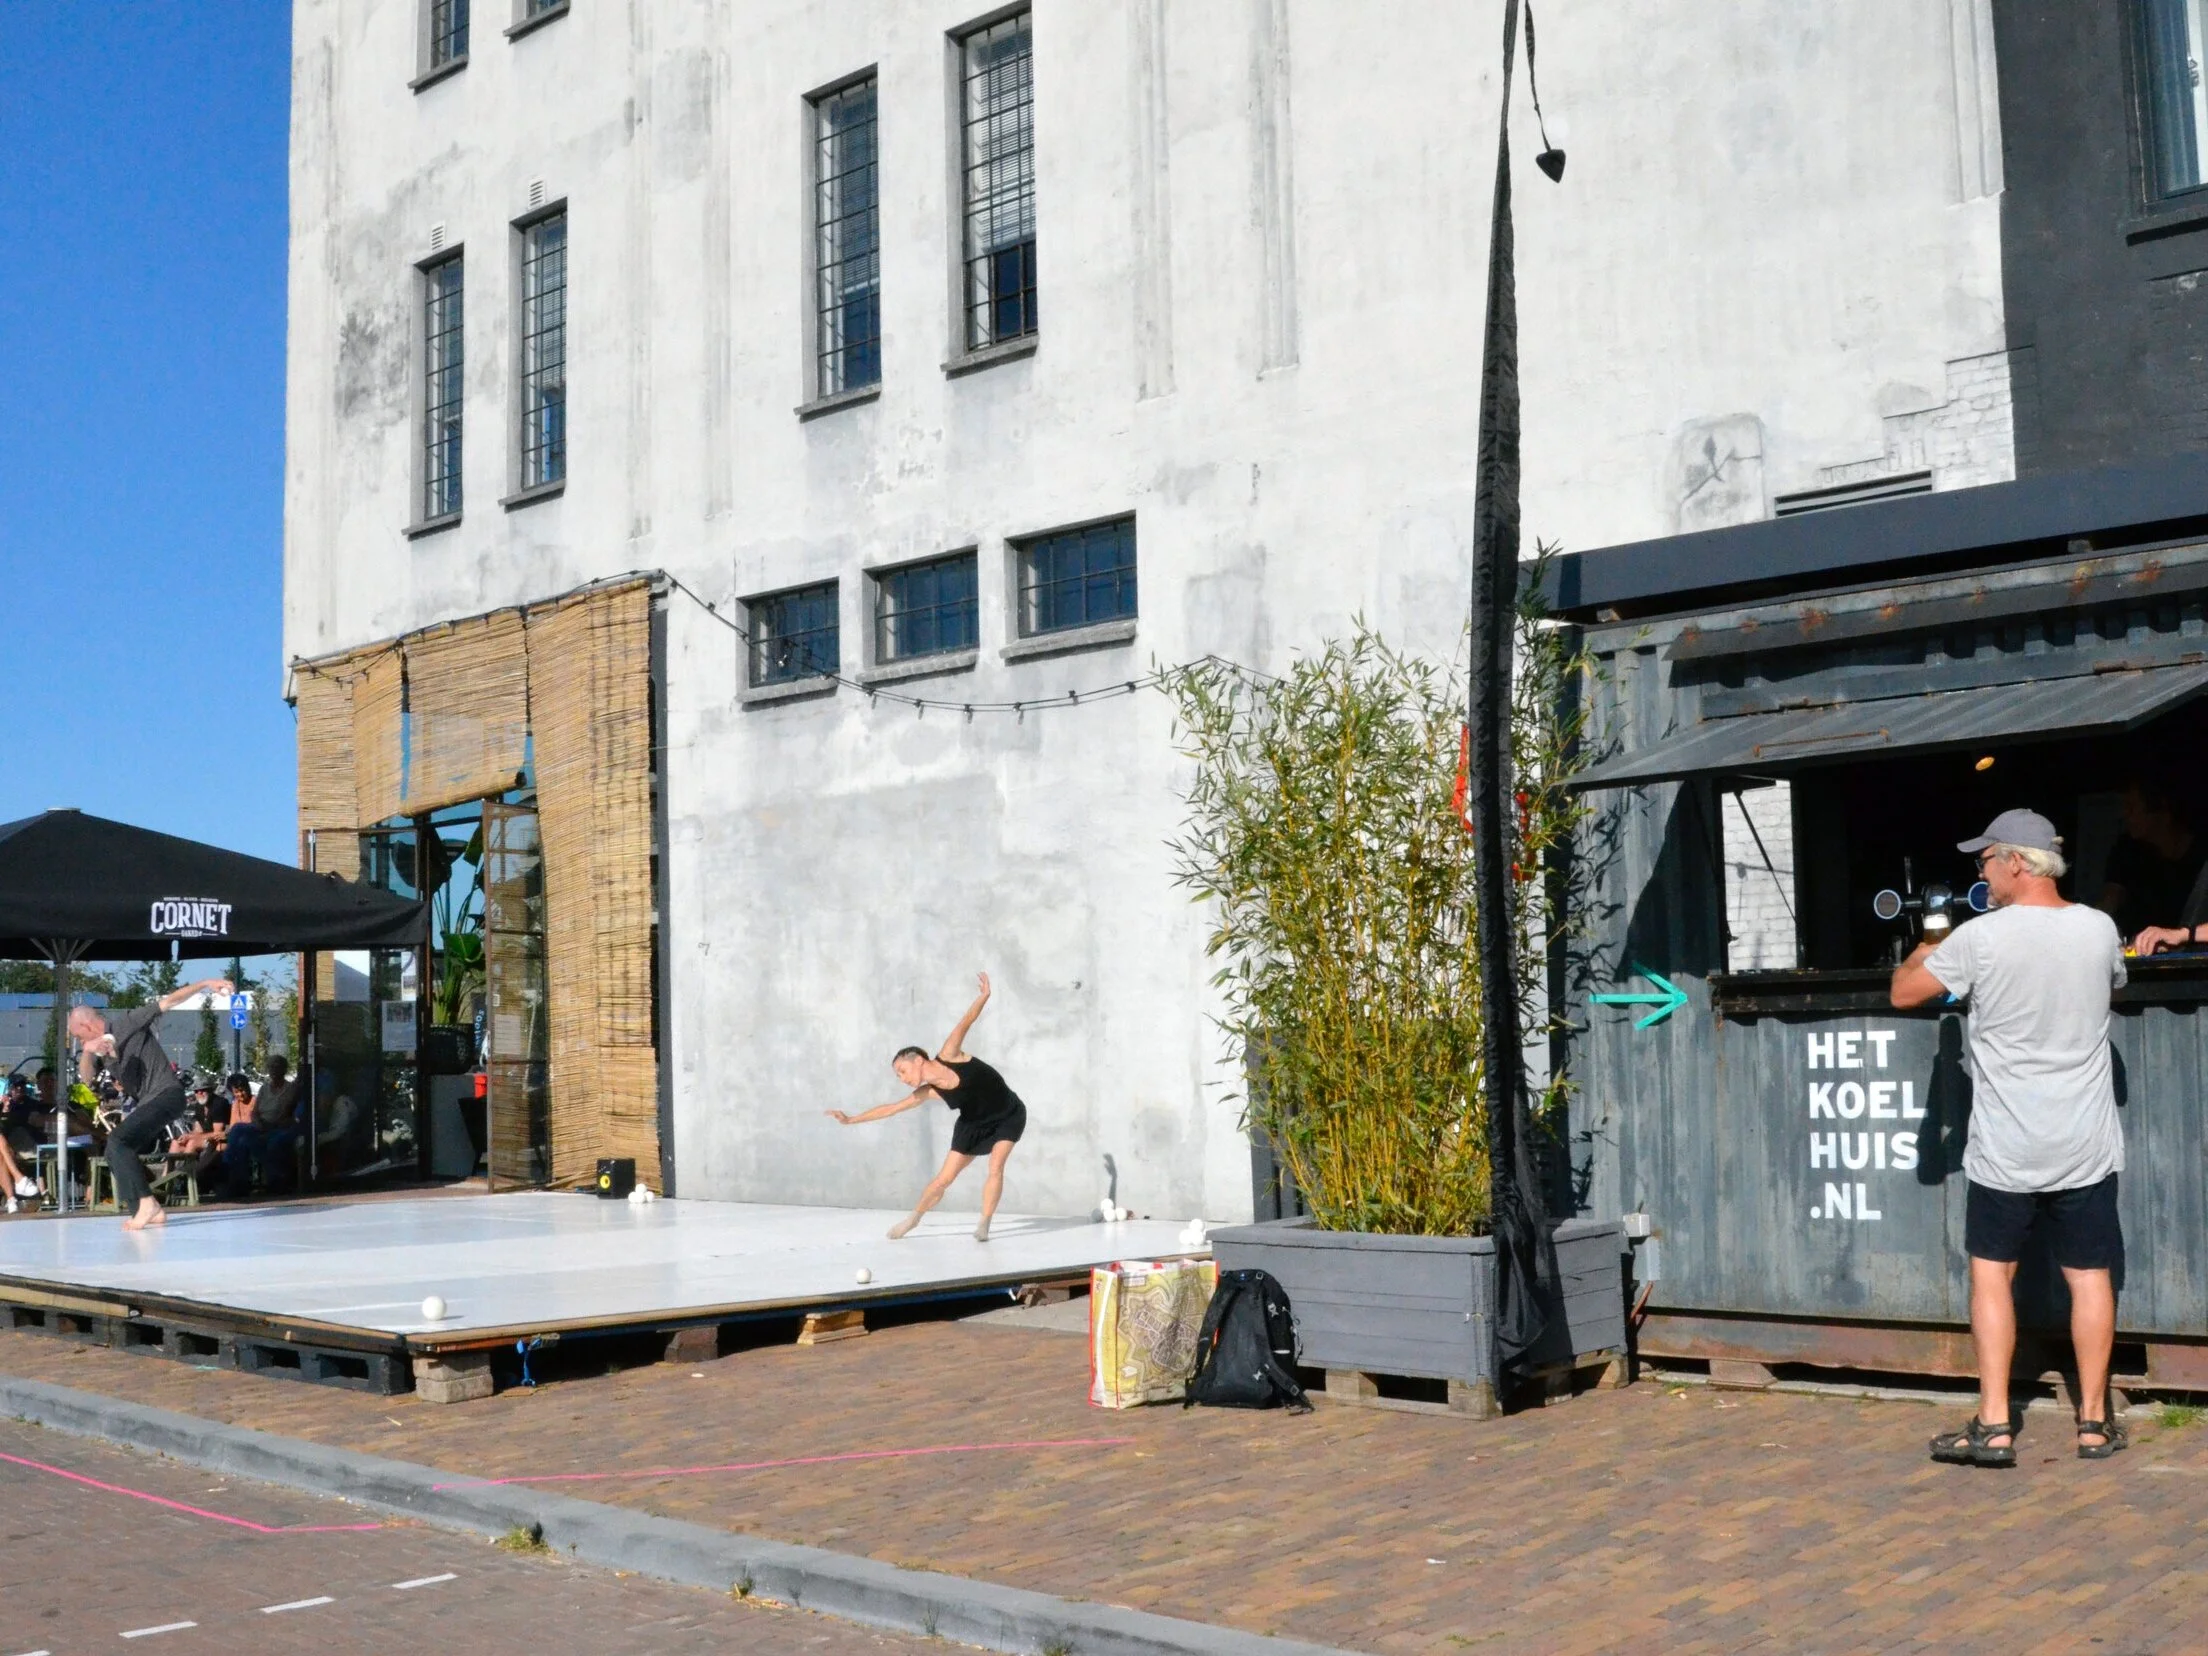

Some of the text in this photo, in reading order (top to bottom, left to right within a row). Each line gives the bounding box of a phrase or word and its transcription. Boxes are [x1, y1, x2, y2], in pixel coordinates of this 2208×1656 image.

[150, 901, 232, 935] CORNET
[1807, 1030, 1896, 1069] HET
[1808, 1081, 1928, 1120] KOEL
[1810, 1131, 1919, 1170] HUIS
[1810, 1182, 1882, 1220] .NL
